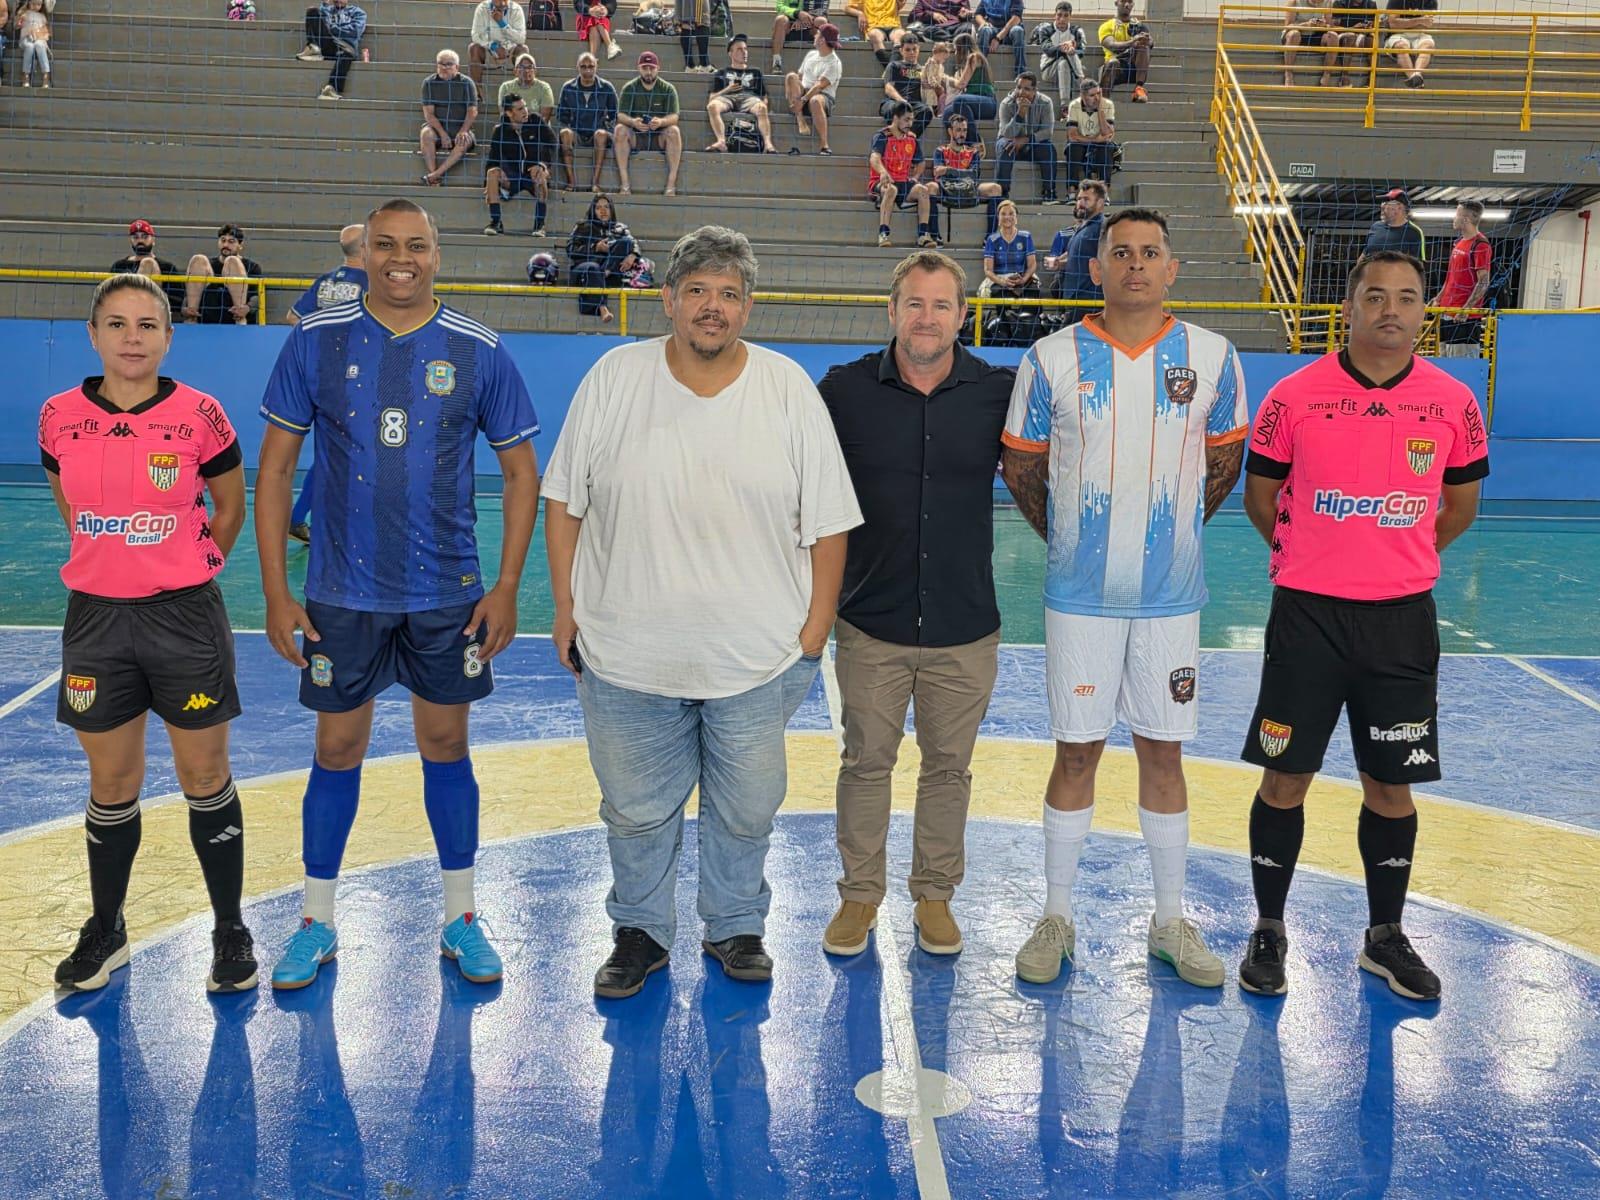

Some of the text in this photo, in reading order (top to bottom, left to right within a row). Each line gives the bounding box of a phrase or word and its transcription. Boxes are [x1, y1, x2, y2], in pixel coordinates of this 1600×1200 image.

[1167, 368, 1195, 380] CAEB
[381, 408, 407, 446] 8
[1411, 441, 1433, 451] FPF
[153, 455, 176, 466] FPF
[1379, 515, 1415, 526] Brasil
[127, 533, 161, 544] Brasil
[464, 642, 483, 677] 8
[70, 678, 91, 688] FPF
[1266, 723, 1287, 736] FPF
